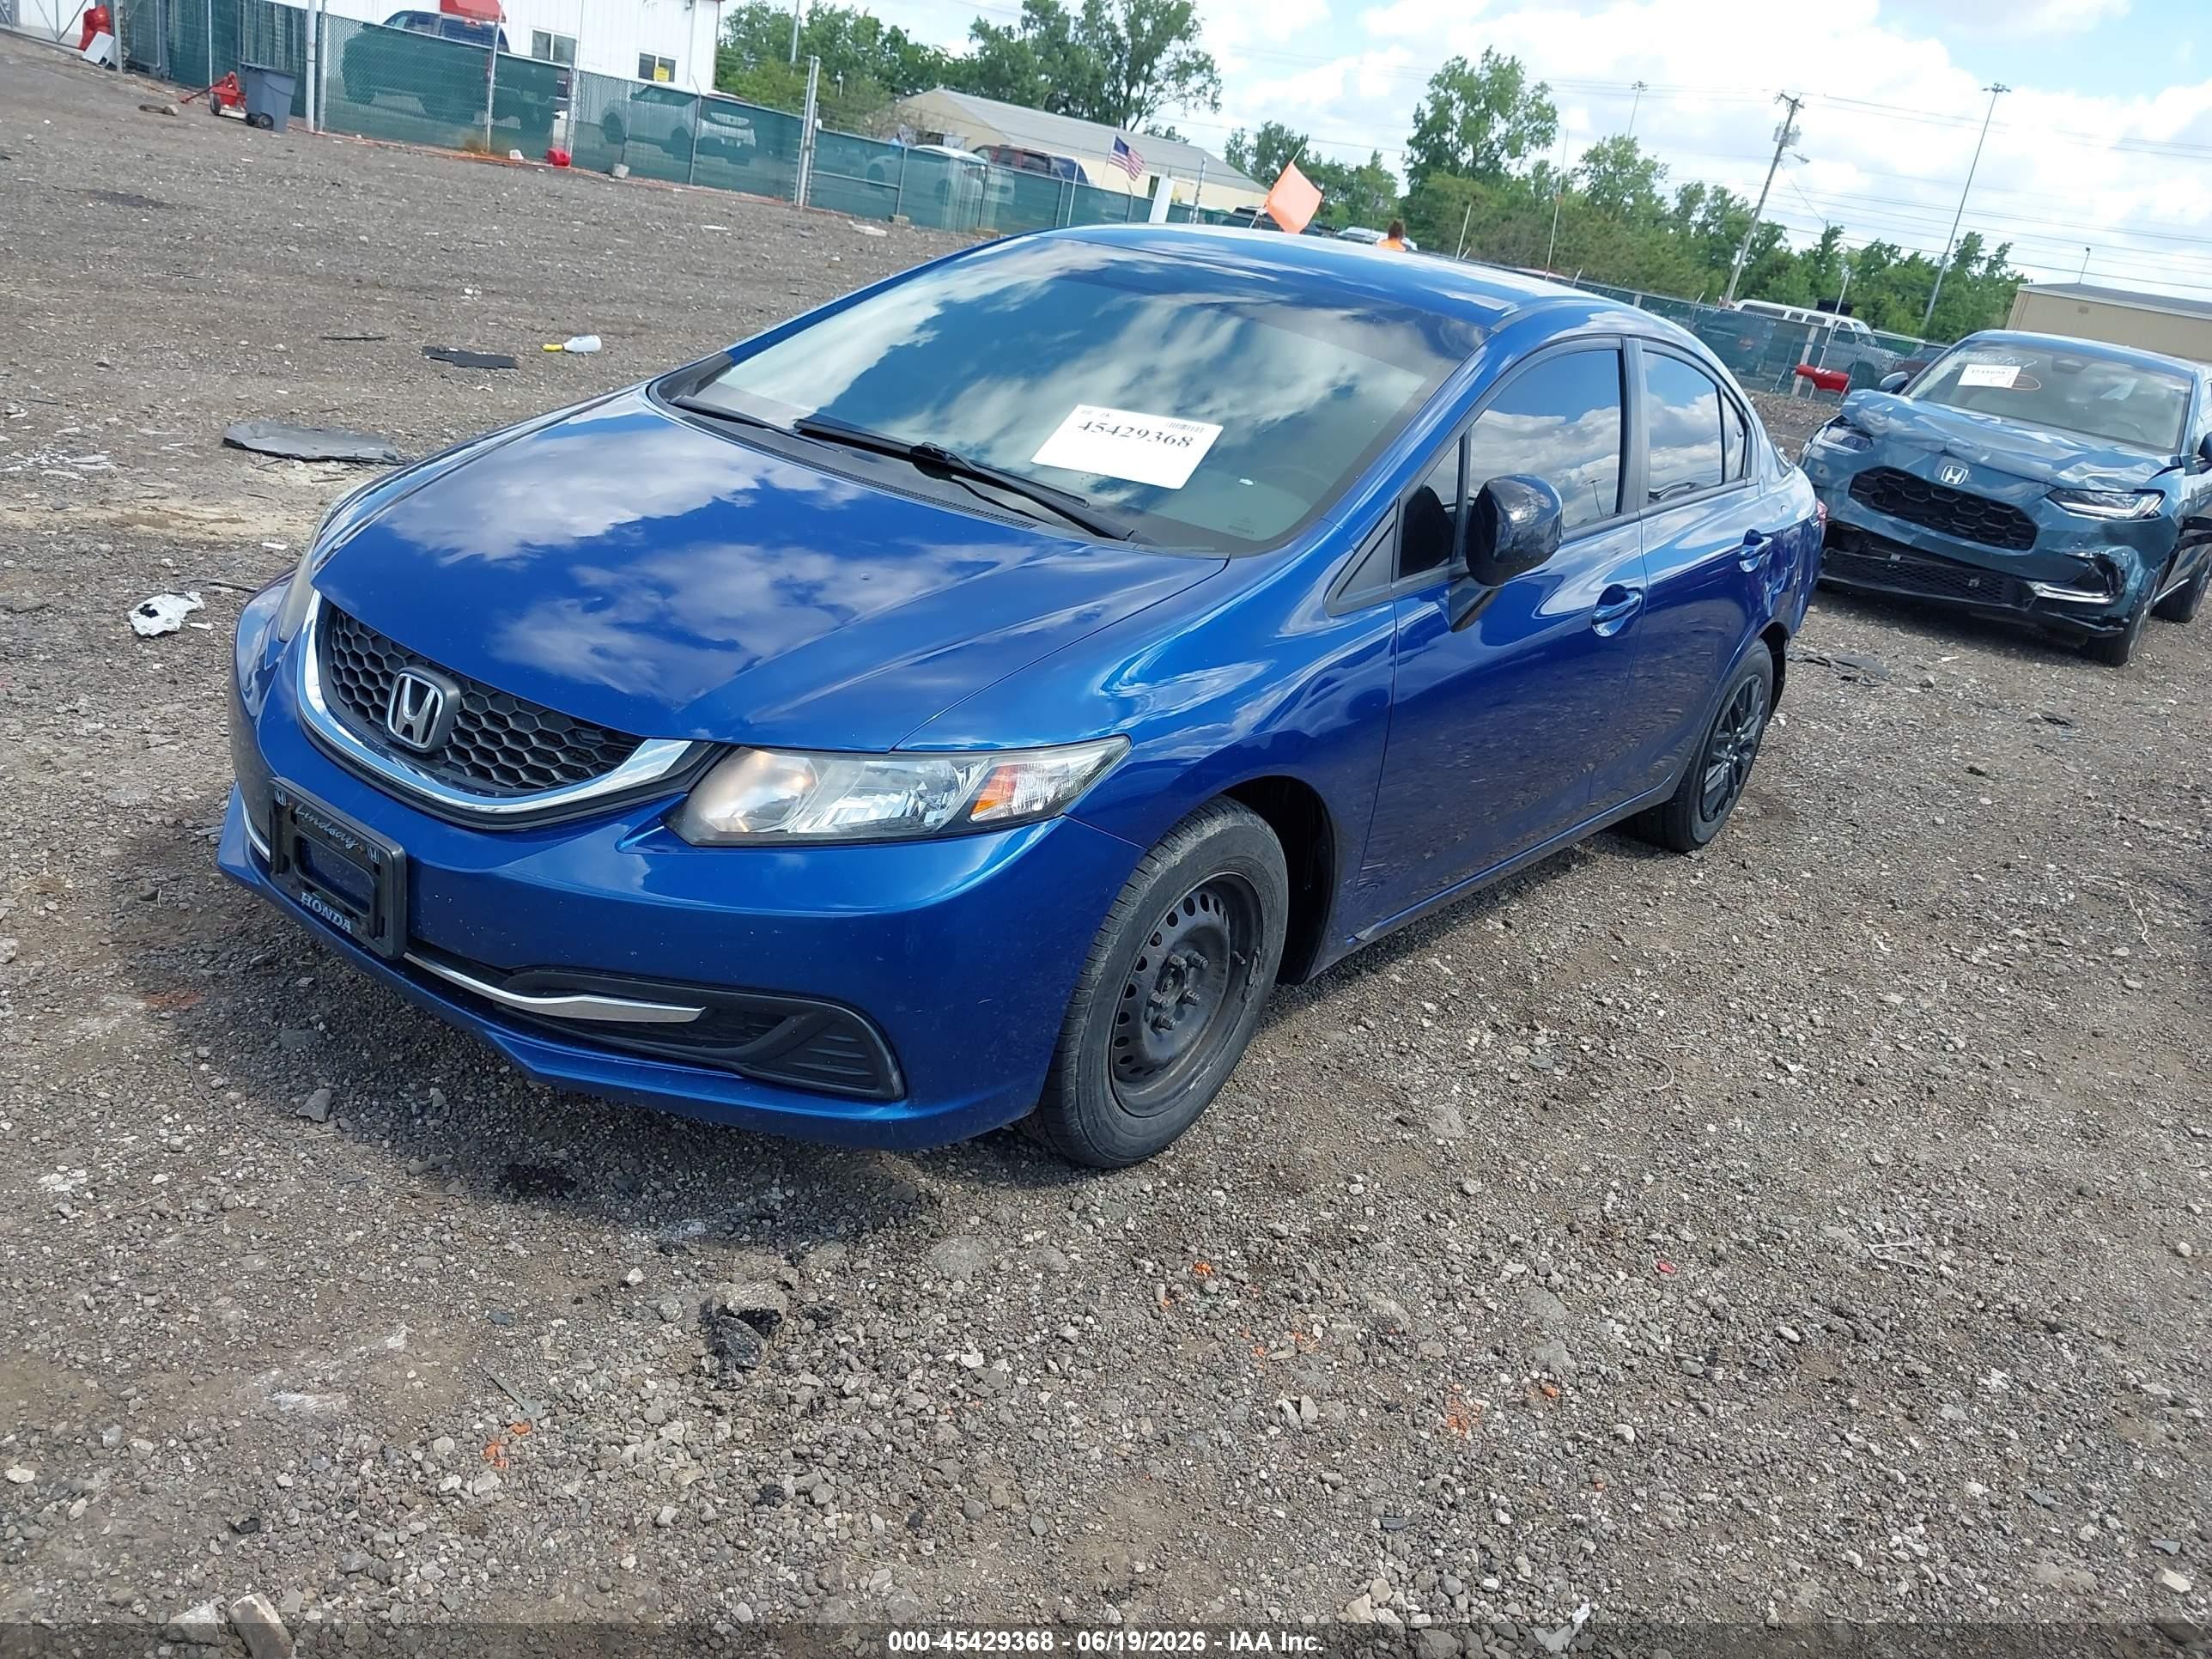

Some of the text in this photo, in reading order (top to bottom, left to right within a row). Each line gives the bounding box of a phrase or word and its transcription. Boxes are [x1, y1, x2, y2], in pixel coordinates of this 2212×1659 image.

[1078, 420, 1194, 448] 45429368
[295, 803, 360, 850] Lindsay
[301, 891, 353, 934] HONDA
